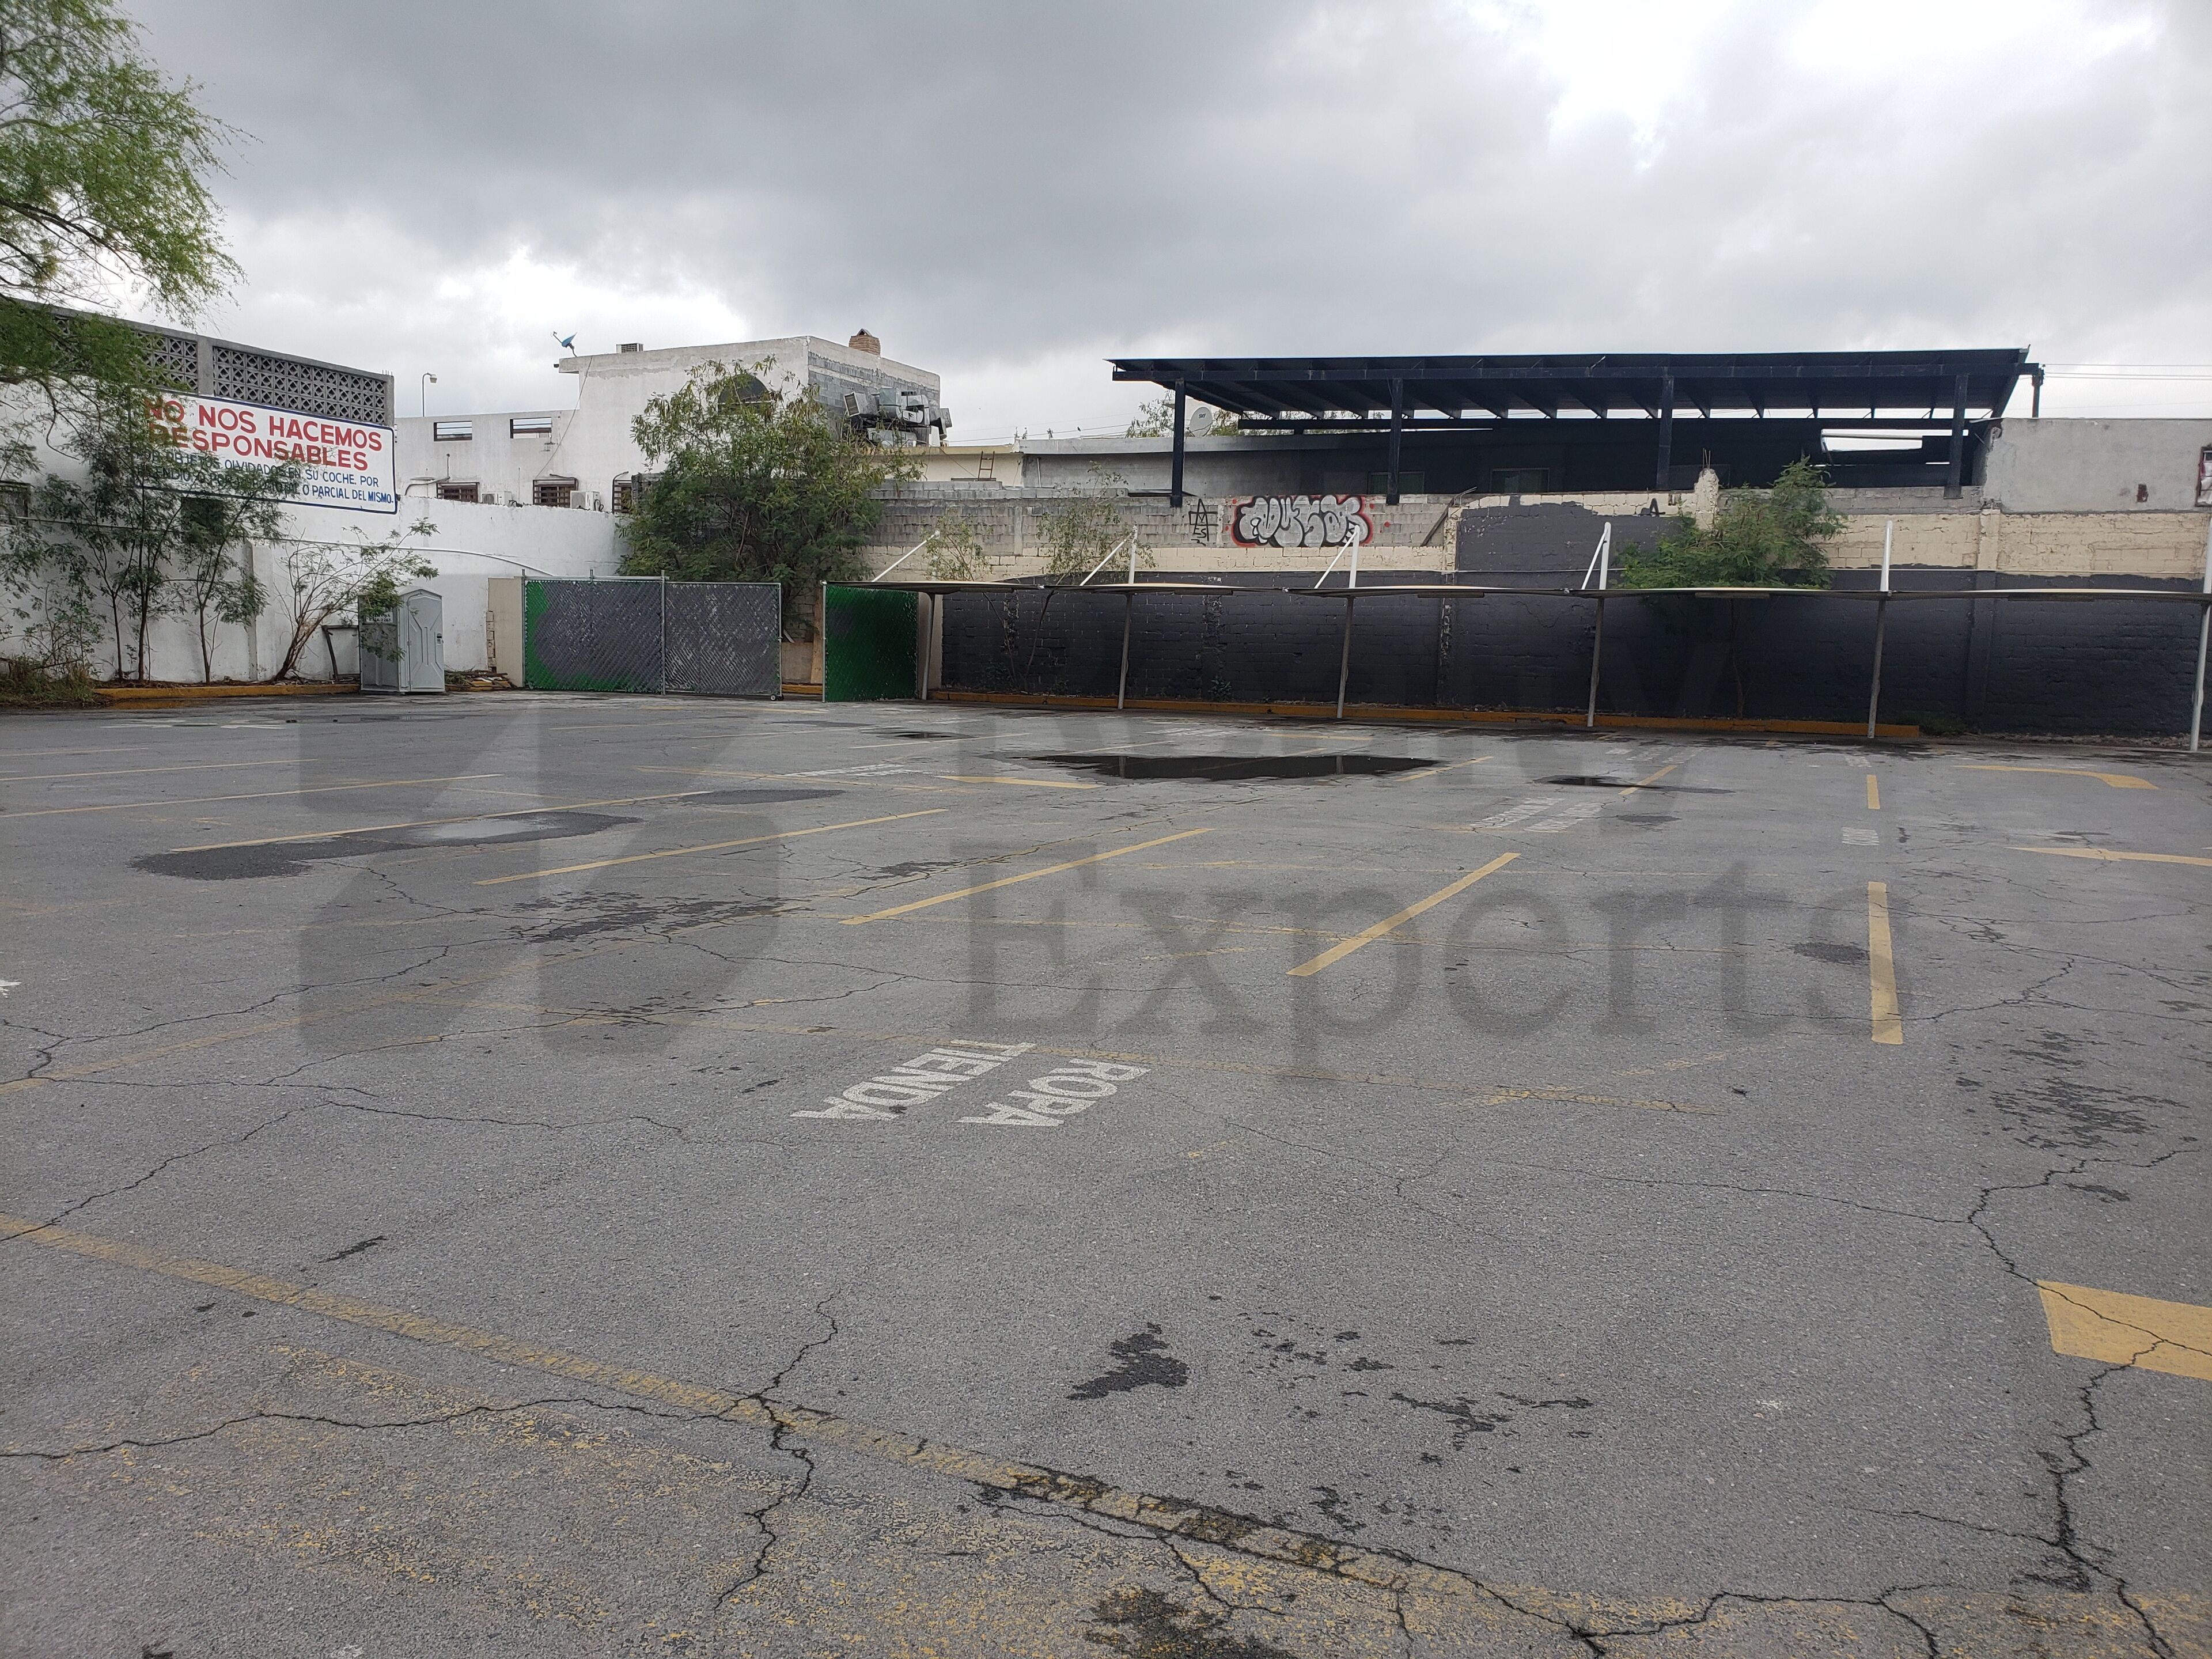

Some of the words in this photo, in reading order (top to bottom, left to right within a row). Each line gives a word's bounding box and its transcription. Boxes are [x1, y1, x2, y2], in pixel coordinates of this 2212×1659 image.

[143, 396, 184, 422] NO
[199, 405, 256, 433] NOS
[269, 416, 382, 451] HACEMOS
[149, 423, 368, 471] RESPONSABLES
[302, 484, 309, 495] O
[312, 485, 350, 499] PARCIAL
[352, 490, 366, 501] DEL
[368, 491, 393, 503] MISMO.
[306, 469, 318, 480] SU
[323, 472, 357, 484] COCHE.
[361, 476, 378, 487] POR
[790, 1040, 1036, 1121] TIENDA
[955, 1058, 1152, 1126] ROPA
